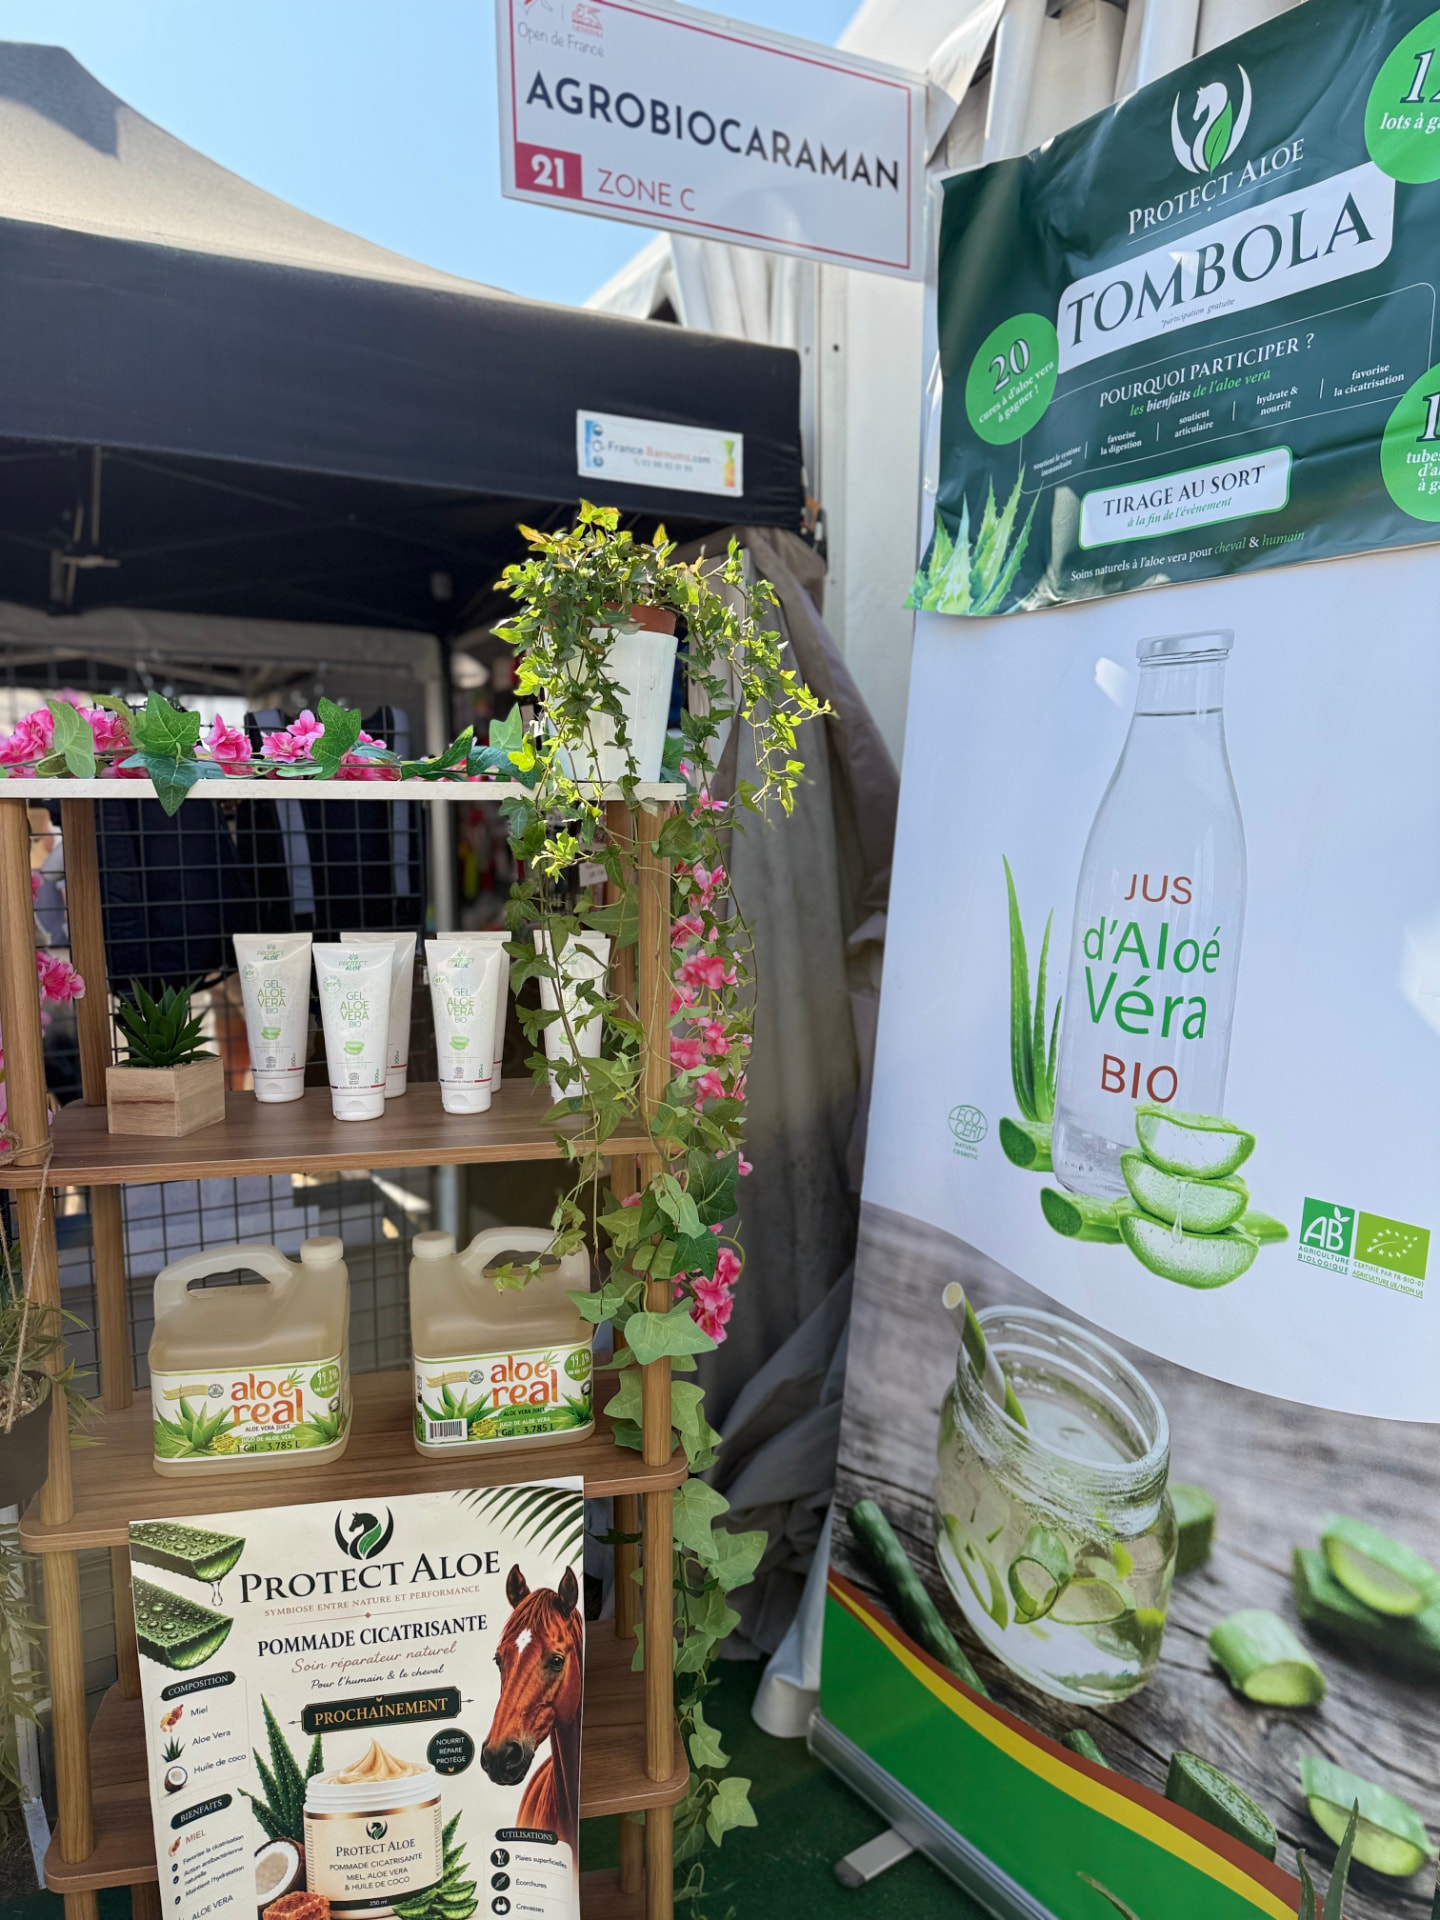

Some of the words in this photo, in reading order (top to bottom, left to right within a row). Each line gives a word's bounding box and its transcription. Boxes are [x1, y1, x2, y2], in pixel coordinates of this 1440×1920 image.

[517, 21, 549, 45] Open
[551, 31, 564, 48] de
[567, 34, 605, 58] France
[1379, 112, 1412, 130] lots
[1413, 112, 1425, 129] à
[526, 70, 898, 191] AGROBIOCARAMAN
[531, 153, 565, 189] 21
[598, 169, 672, 207] ZONE
[681, 188, 695, 212] C
[1128, 172, 1232, 235] PROTECT
[1238, 139, 1304, 188] ALOE
[1067, 192, 1376, 346] TOMBOLA
[1207, 298, 1236, 315] gratuite
[989, 338, 1030, 395] 20
[1100, 368, 1185, 407] POURQUOI
[1190, 336, 1299, 381] PARTICIPER
[1306, 332, 1315, 349] ?
[1352, 364, 1390, 381] favorise
[979, 404, 1002, 424] cures
[1001, 393, 1008, 406] à
[1036, 361, 1054, 379] vera
[1130, 404, 1145, 417] les
[1146, 389, 1191, 413] bienfaits
[1193, 384, 1206, 398] de
[1208, 376, 1241, 394] l'aloe
[1245, 370, 1271, 384] vera
[1333, 387, 1342, 397] la
[1345, 373, 1405, 395] cicatrisation
[1256, 388, 1289, 405] hydrate
[1290, 386, 1299, 395] &
[1004, 392, 1034, 420] gagner
[1260, 400, 1291, 416] nourrit
[1179, 409, 1210, 425] soutient
[1107, 430, 1136, 444] favorise
[1174, 420, 1214, 438] articulaire
[1100, 446, 1107, 456] la
[1108, 439, 1142, 454] digestion
[1103, 486, 1174, 517] TIRAGE
[1178, 479, 1205, 502] AU
[1210, 464, 1266, 494] SORT
[1417, 478, 1426, 491] à
[1127, 515, 1133, 527] à
[1135, 513, 1145, 526] la
[1147, 511, 1161, 528] fin
[1163, 509, 1174, 521] de
[1070, 568, 1093, 582] Soins
[1095, 559, 1130, 576] naturels
[1132, 558, 1139, 570] à
[1167, 552, 1188, 565] vera
[1189, 546, 1213, 565] pour
[1214, 537, 1247, 554] cheval
[1248, 536, 1260, 549] &
[1261, 529, 1305, 547] humain
[1124, 873, 1193, 905] JUS
[1083, 916, 1221, 973] d'Aloé
[257, 988, 286, 997] ALOE
[264, 980, 281, 988] GEL
[453, 987, 470, 996] GEL
[257, 998, 286, 1007] VERA
[346, 991, 365, 1000] GEL
[447, 997, 475, 1007] ALOE
[1085, 966, 1207, 1040] Véra
[340, 1001, 370, 1010] ALOE
[447, 1007, 474, 1016] VERA
[340, 1010, 370, 1021] VERA
[454, 1016, 467, 1024] BIO
[1101, 1053, 1178, 1103] BIO
[1303, 1215, 1344, 1251] AB
[1298, 1245, 1350, 1266] AGRICULTURE
[1298, 1253, 1349, 1274] BIOLOGIQUE
[1352, 1269, 1389, 1286] AGRICULTURE
[1380, 1268, 1392, 1278] PAR
[490, 1355, 549, 1383] aloe
[230, 1373, 294, 1401] aloe
[492, 1369, 558, 1408] real
[232, 1388, 304, 1427] real
[503, 1409, 517, 1417] ALOE
[532, 1406, 546, 1415] JUICE
[245, 1425, 259, 1433] ALOE
[261, 1424, 275, 1432] VERA
[276, 1423, 291, 1431] JUICE
[499, 1420, 513, 1429] JUGO
[536, 1416, 551, 1424] VERA
[501, 1427, 515, 1437] Gal
[524, 1424, 548, 1435] 3.785
[241, 1436, 256, 1445] JUGO
[243, 1443, 257, 1452] Gal
[267, 1440, 293, 1451] 3.785
[238, 1561, 405, 1604] PROTECT
[409, 1550, 501, 1583] ALOE
[264, 1604, 314, 1617] SYMBIOSE
[317, 1600, 349, 1612] ENTRE
[352, 1595, 392, 1608] NATURE
[394, 1593, 407, 1602] ET
[410, 1584, 481, 1600] PERFORMANCE
[257, 1630, 356, 1656] POMMADE
[360, 1614, 488, 1645] CICATRISANTE
[291, 1658, 327, 1673] Soin
[330, 1651, 402, 1673] réparateur
[405, 1641, 458, 1659] naturel
[168, 1675, 229, 1696] COMPOSITION
[311, 1679, 335, 1690] Pour
[337, 1674, 384, 1687] l'humain
[386, 1670, 396, 1680] &
[399, 1668, 409, 1679] le
[411, 1664, 445, 1677] cheval
[190, 1705, 208, 1716] Miel
[192, 1735, 211, 1746] Aloe
[212, 1730, 231, 1739] Vera
[436, 1736, 465, 1746] NOURRIT
[438, 1745, 463, 1755] RÉPARE
[193, 1762, 214, 1774] Huile
[215, 1758, 226, 1767] de
[228, 1753, 247, 1763] coco
[180, 1799, 223, 1823] BIENFAITS
[185, 1829, 206, 1844] MIEL
[501, 1831, 553, 1841] UTILISATIONS
[336, 1843, 386, 1857] PROTECT
[387, 1838, 416, 1852] ALOE
[184, 1864, 201, 1877] Action
[329, 1861, 369, 1871] POMMADE
[370, 1852, 423, 1868] CICATRISANTE
[515, 1854, 532, 1862] Plaies
[533, 1857, 567, 1869] superficielles
[367, 1870, 388, 1879] ALOE
[389, 1867, 408, 1876] VERA
[351, 1881, 373, 1890] HUILE
[375, 1880, 386, 1888] DE
[387, 1876, 410, 1887] COCO
[191, 1905, 211, 1920] ALOE
[213, 1894, 234, 1909] VERA
[516, 1903, 545, 1913] Crevasses
